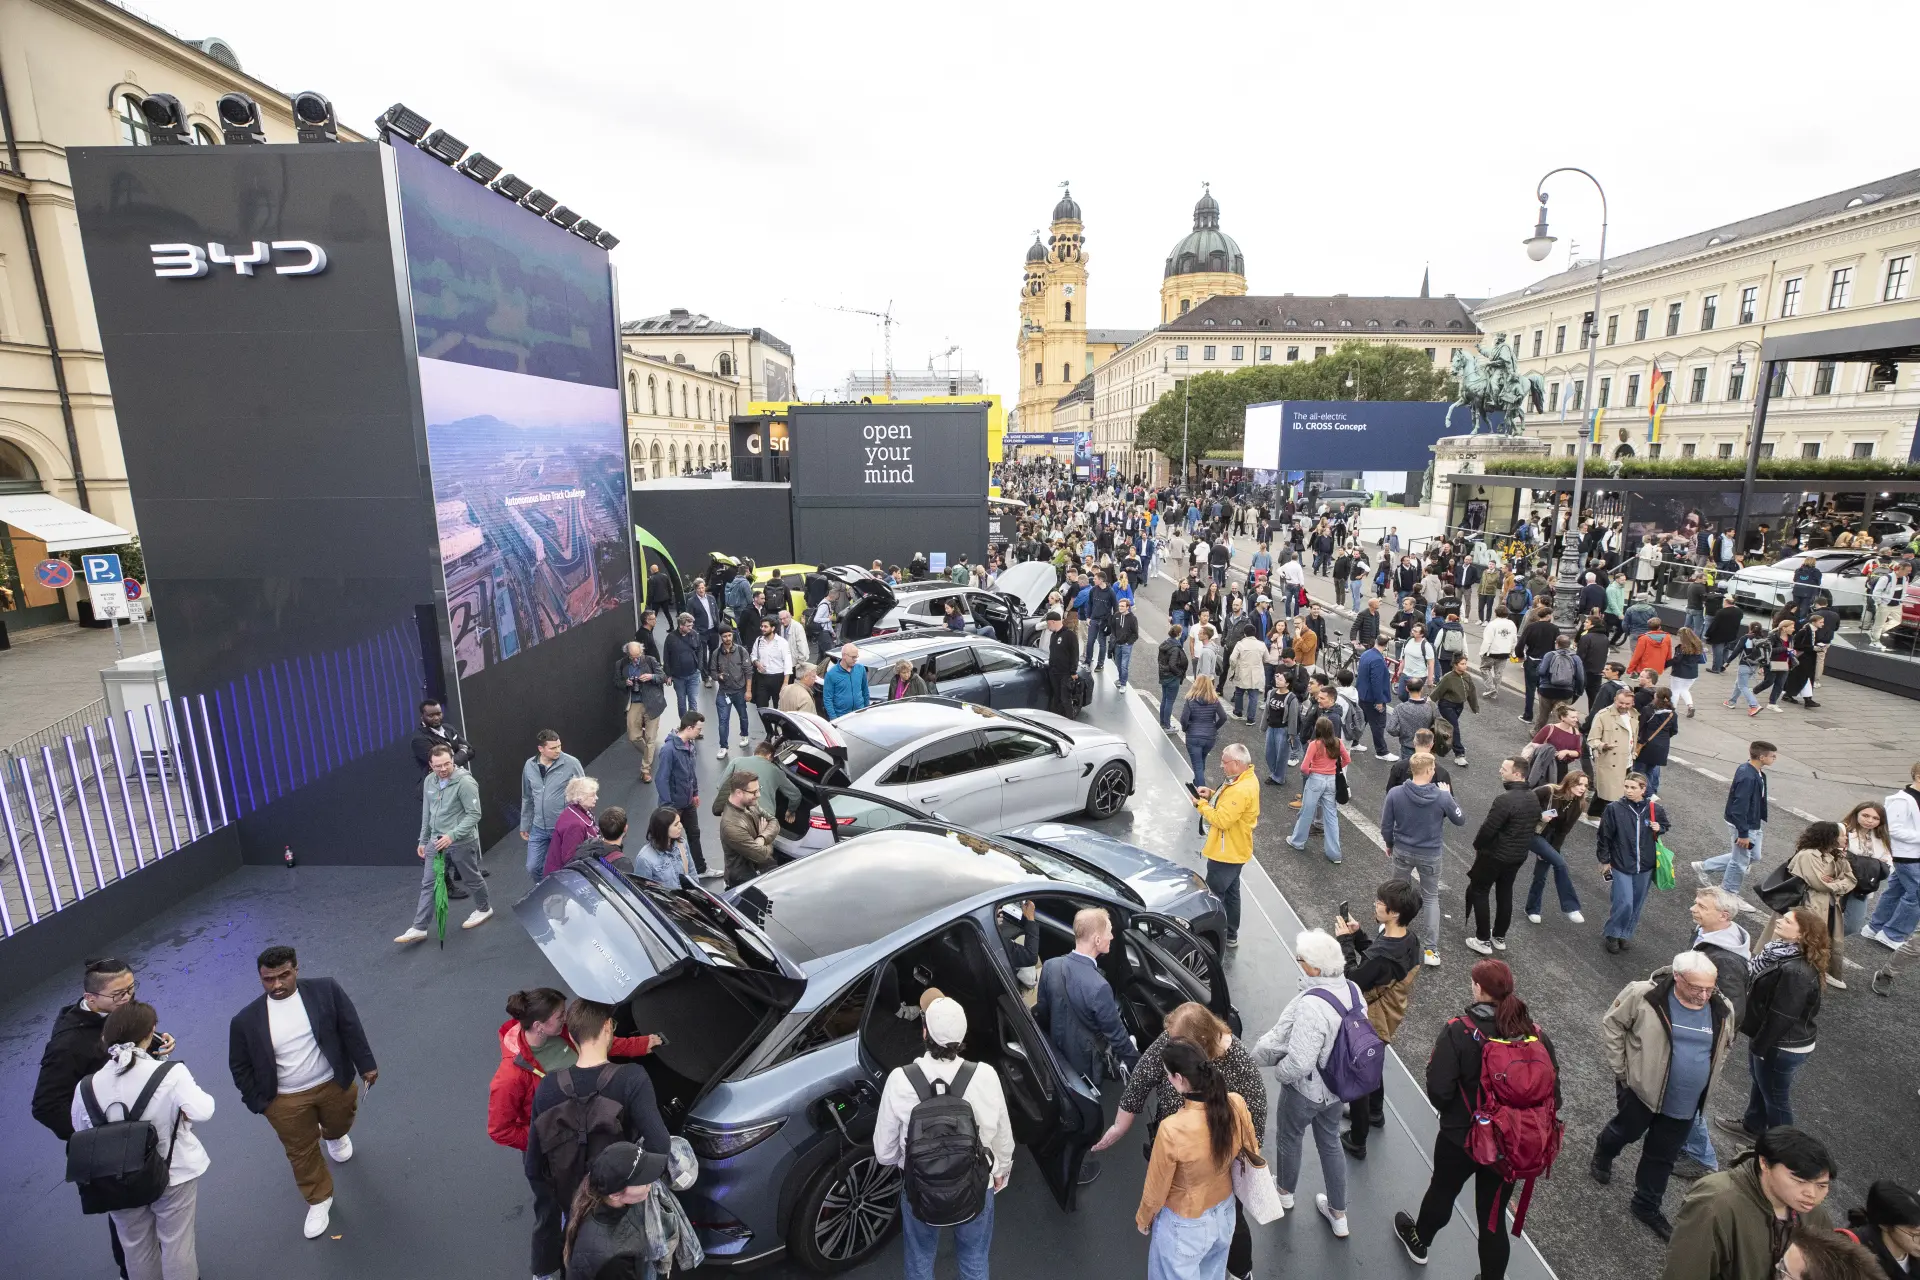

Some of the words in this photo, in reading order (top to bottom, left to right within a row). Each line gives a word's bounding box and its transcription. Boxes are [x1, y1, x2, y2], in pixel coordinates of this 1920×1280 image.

[149, 240, 328, 278] BYD
[1293, 412, 1308, 420] The
[1309, 412, 1347, 421] all-electric
[863, 424, 913, 444] open
[1292, 422, 1304, 430] ID.
[1305, 422, 1333, 430] CROSS
[1334, 422, 1367, 432] Concept
[864, 446, 912, 466] your
[864, 464, 915, 483] mind
[504, 495, 539, 507] Autonomous
[539, 492, 552, 502] Race
[551, 490, 564, 501] Track
[564, 488, 586, 499] Challenge
[88, 558, 109, 581] P
